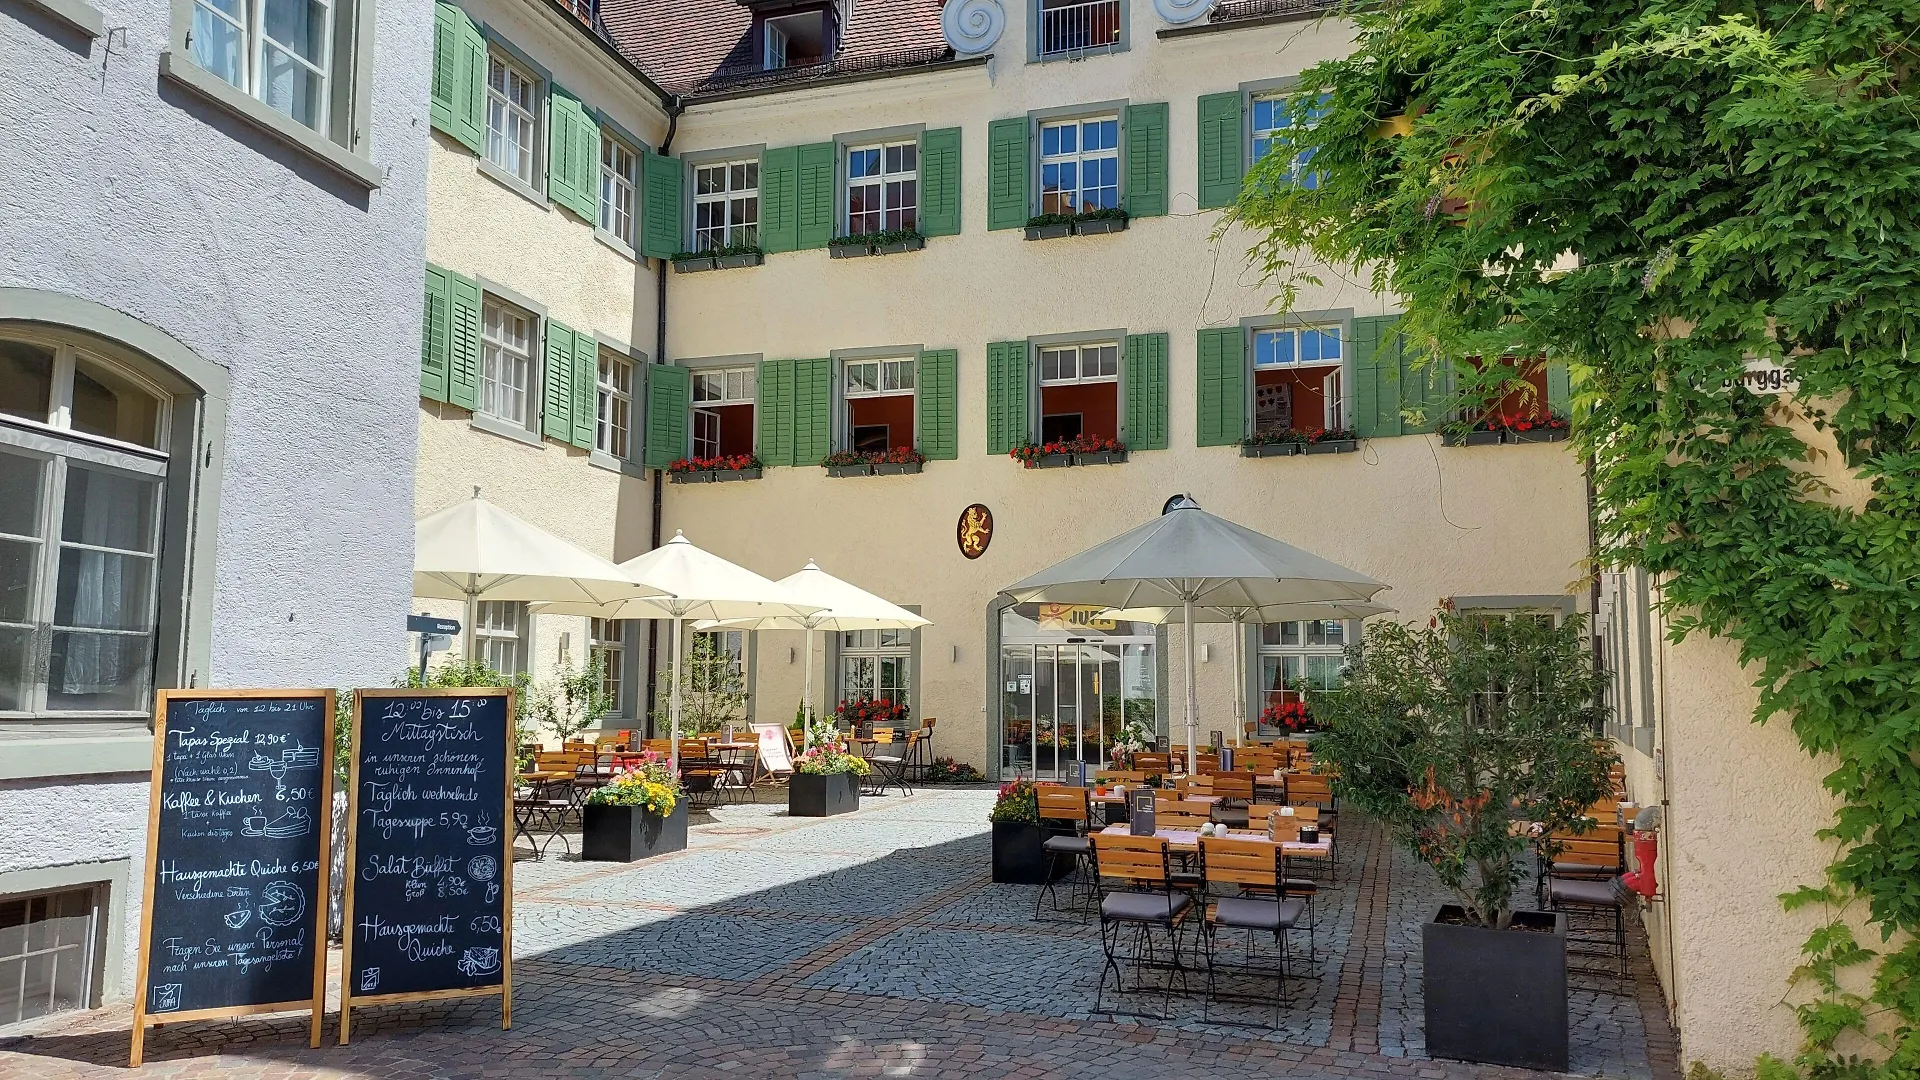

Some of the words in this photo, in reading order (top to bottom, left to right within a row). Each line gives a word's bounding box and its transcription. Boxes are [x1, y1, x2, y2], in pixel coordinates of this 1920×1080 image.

[253, 703, 267, 713] 12
[268, 702, 281, 712] bis
[283, 703, 297, 712] 21
[421, 699, 445, 720] bis
[168, 727, 209, 752] Tapas
[209, 729, 250, 753] Spezial
[381, 721, 484, 751] Mittagstisch
[364, 752, 378, 764] in
[374, 763, 421, 782] ruhigen
[163, 791, 201, 813] Kaffee
[204, 789, 216, 806] &
[218, 788, 262, 805] Kuchen
[363, 781, 418, 812] Täglich
[422, 785, 479, 802] wechselnde
[363, 808, 436, 840] Tagessuppe
[160, 859, 247, 890] Hausgemachte
[250, 858, 288, 877] Quiche
[362, 854, 412, 881] Salat
[162, 936, 203, 961] Fragen
[204, 937, 222, 956] Sie
[255, 926, 305, 950] Personal
[358, 914, 460, 951] Hausgemachte
[407, 938, 456, 962] Quiche
[162, 961, 189, 974] nach
